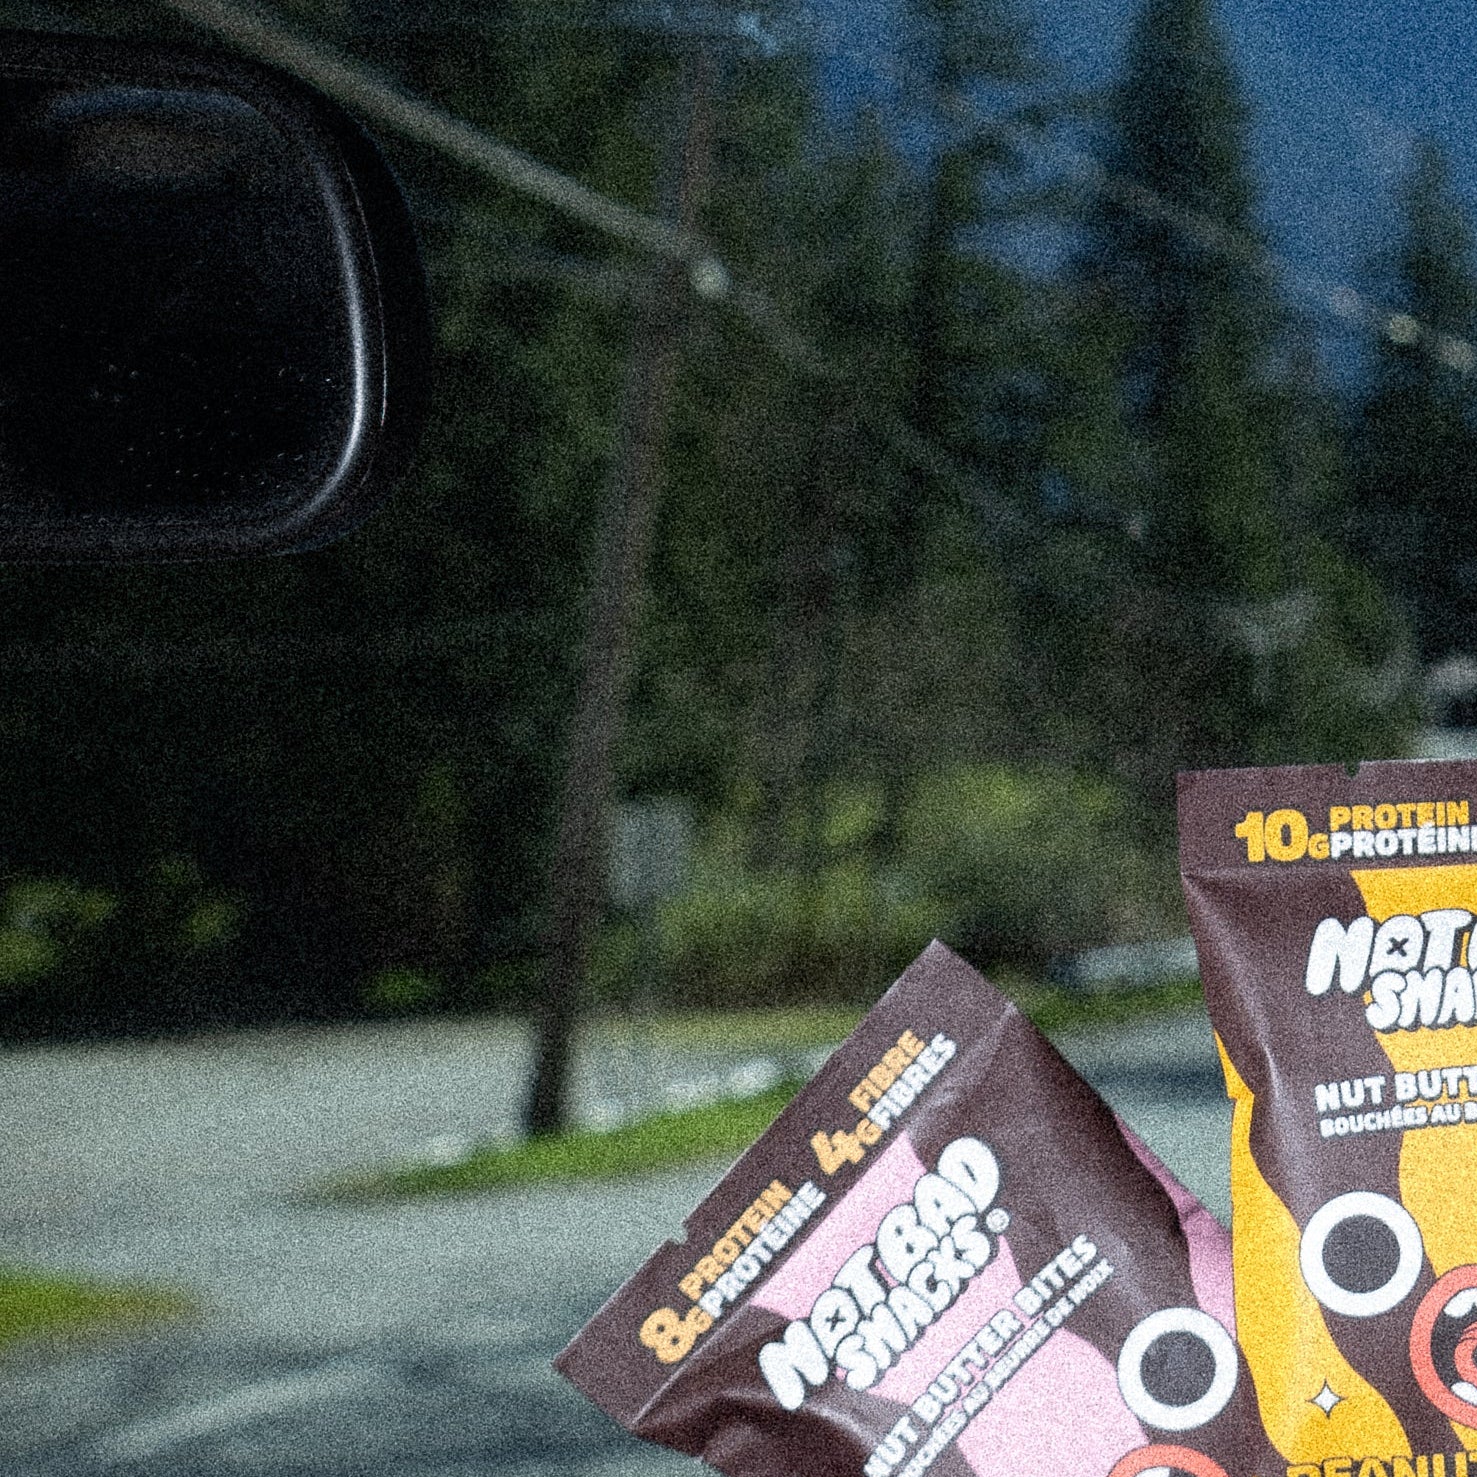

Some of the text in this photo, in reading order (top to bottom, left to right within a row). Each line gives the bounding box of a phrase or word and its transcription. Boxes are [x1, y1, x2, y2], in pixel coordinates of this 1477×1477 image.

[1329, 800, 1470, 832] PROTEIN
[1305, 908, 1472, 997] NOT
[848, 1029, 927, 1113] FIBRE
[866, 1033, 958, 1131] FIBRES
[1315, 1076, 1386, 1114] NUT
[1430, 1102, 1460, 1126] AU
[678, 1178, 794, 1301] PROTEIN
[697, 1180, 827, 1320] PROTÉINE
[758, 1136, 1000, 1411] NOT BAD
[837, 1215, 991, 1393] SNACKS
[912, 1309, 1024, 1424] BUTTER
[1013, 1234, 1098, 1317] BITES
[962, 1383, 991, 1416] AU
[1045, 1297, 1075, 1327] DE
[1068, 1257, 1115, 1304] NOIX
